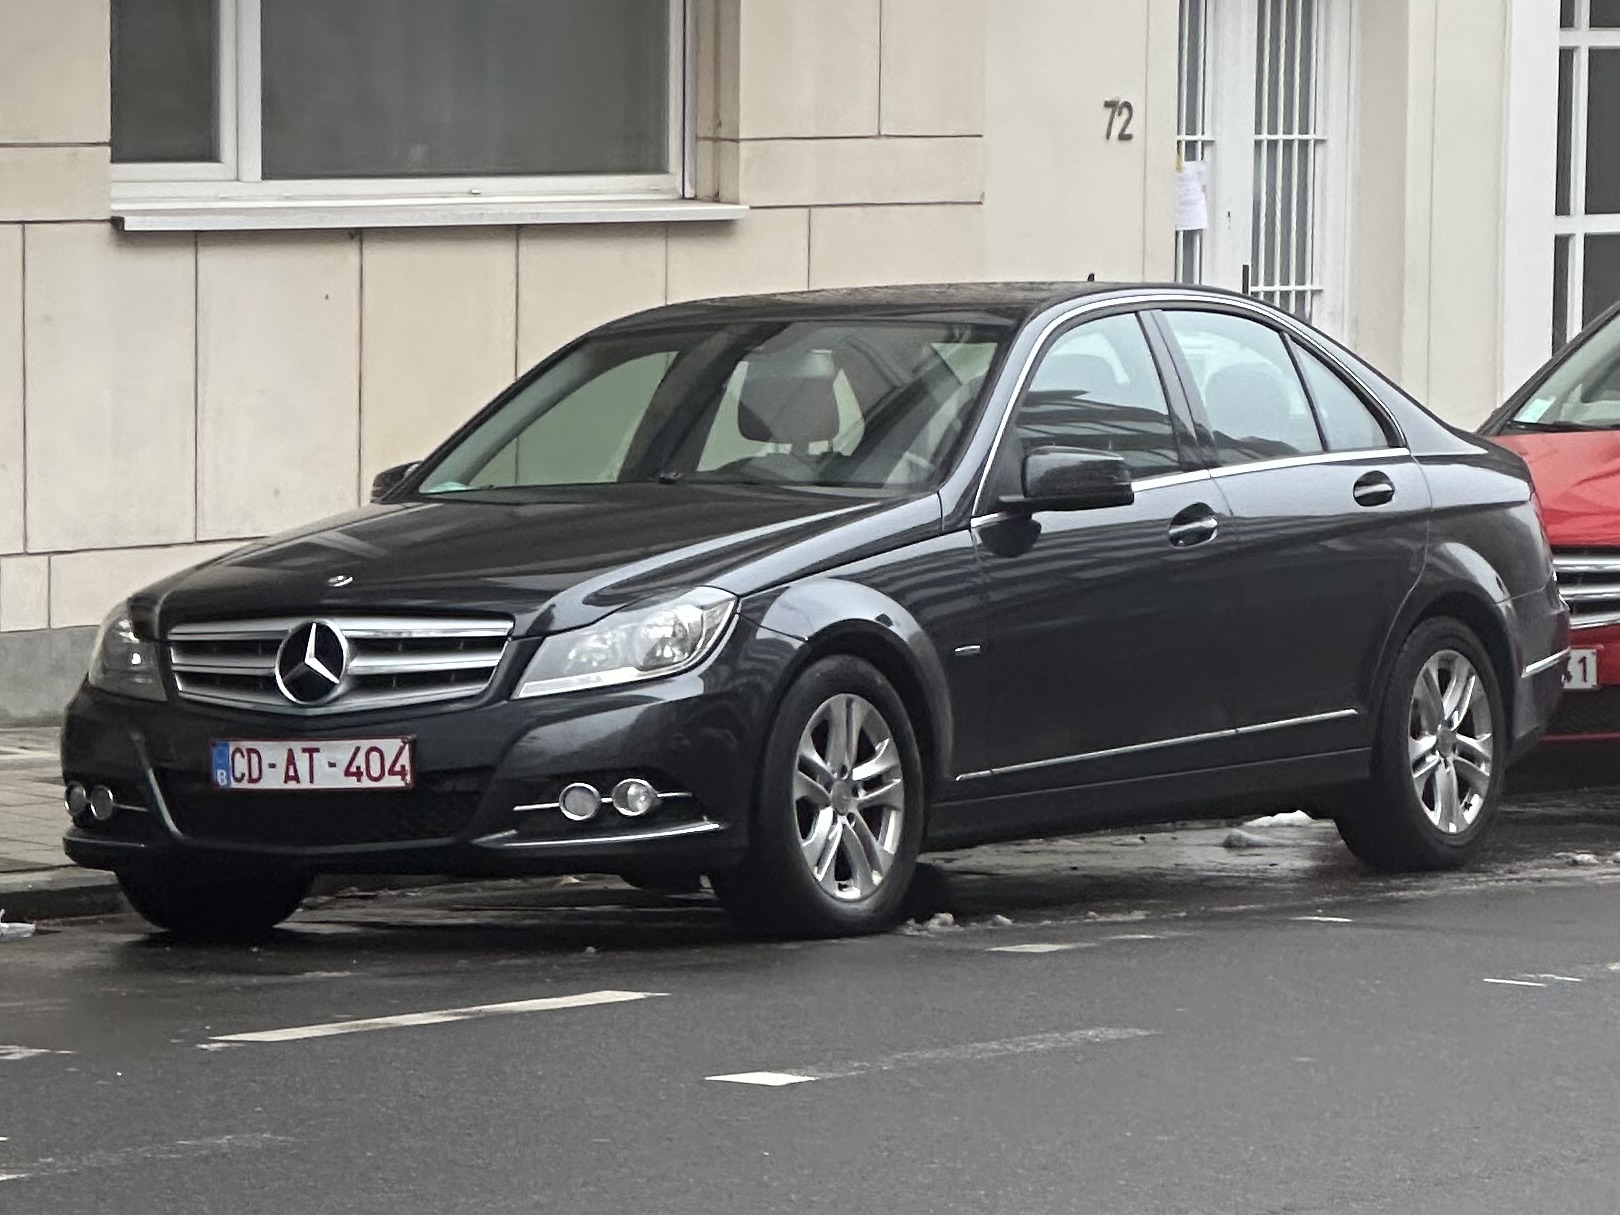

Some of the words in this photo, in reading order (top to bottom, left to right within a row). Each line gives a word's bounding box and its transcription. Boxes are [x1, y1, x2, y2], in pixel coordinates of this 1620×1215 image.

[1104, 100, 1133, 140] 72
[216, 769, 228, 786] B
[231, 746, 408, 784] CD-AT-404
